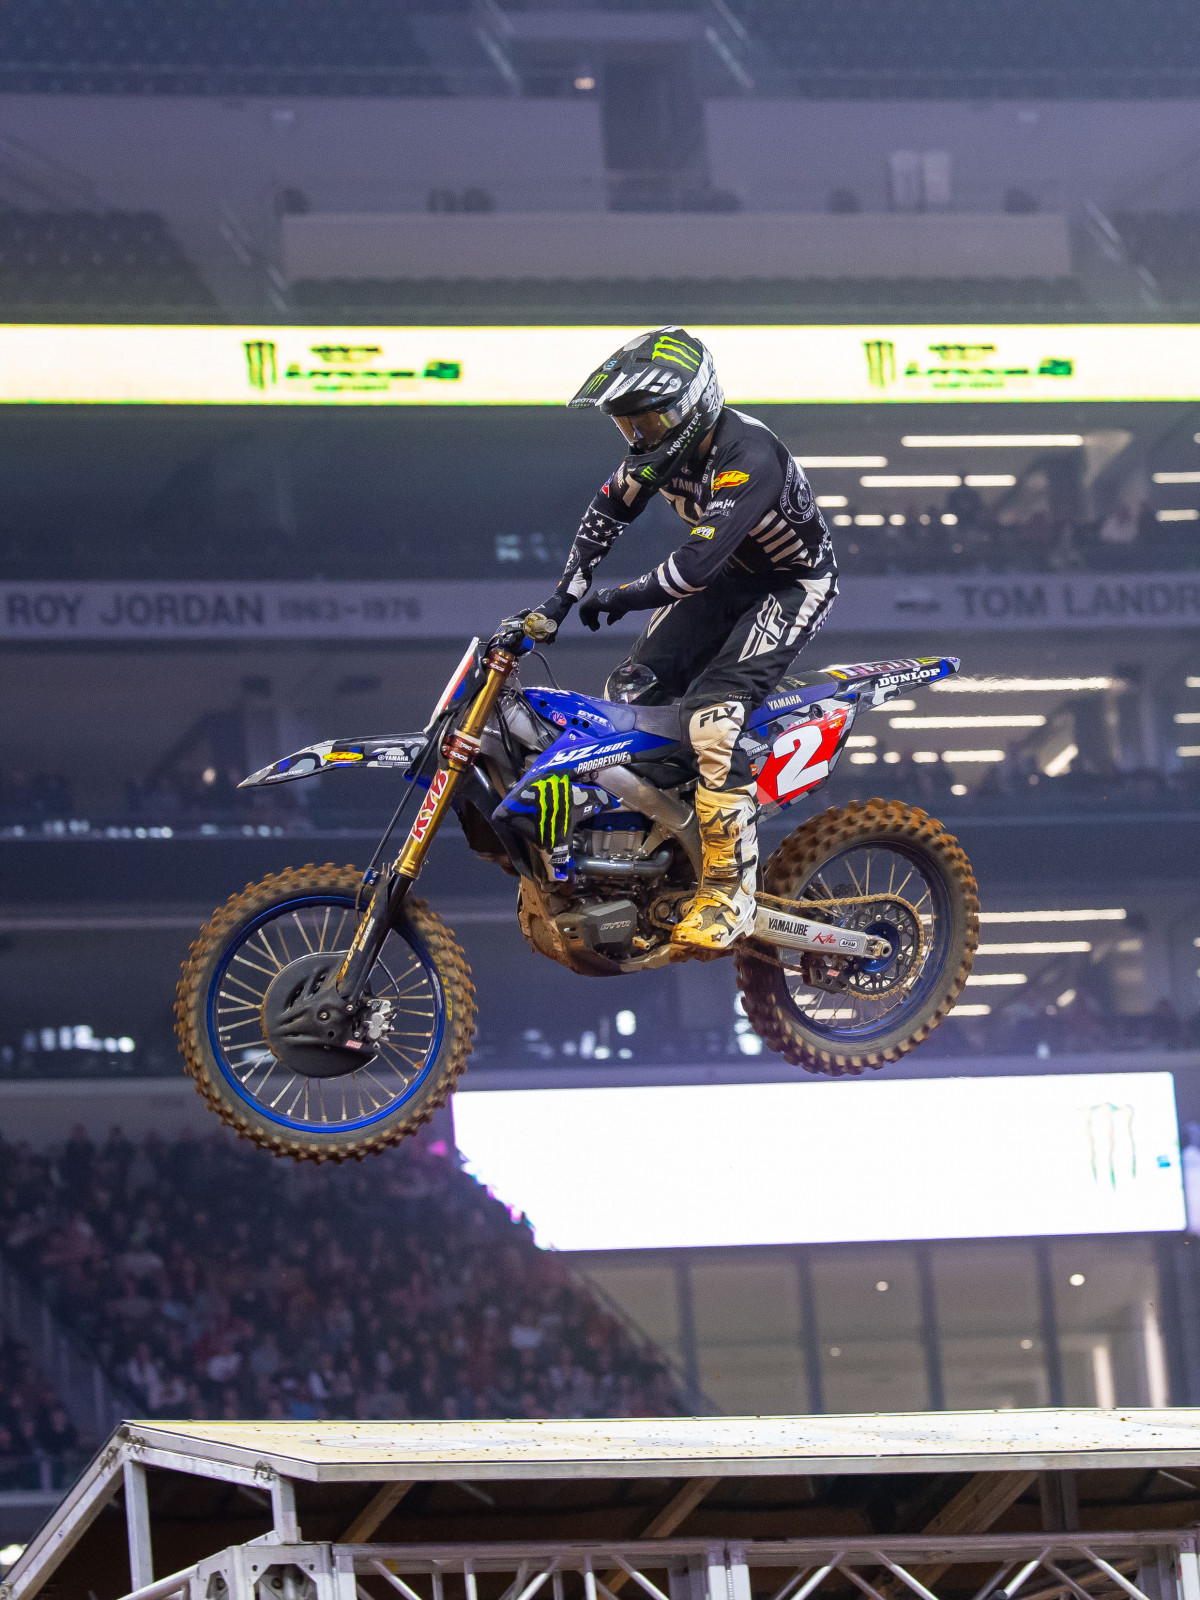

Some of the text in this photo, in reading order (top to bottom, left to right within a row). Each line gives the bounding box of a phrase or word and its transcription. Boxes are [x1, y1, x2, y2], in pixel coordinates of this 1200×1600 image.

[667, 412, 702, 456] MONSTER
[672, 478, 703, 496] YAMA
[6, 592, 84, 626] ROY
[100, 592, 266, 626] JORDAN
[956, 584, 1048, 619] TOM
[878, 667, 941, 687] DUNLOP
[767, 694, 803, 711] YAMAHA
[700, 705, 738, 728] FLY
[577, 751, 629, 774] PROGRESSIVE
[773, 725, 829, 797] 2
[358, 917, 376, 952] BRAKING
[768, 917, 808, 937] YAMALUBE
[841, 940, 857, 948] AFAM
